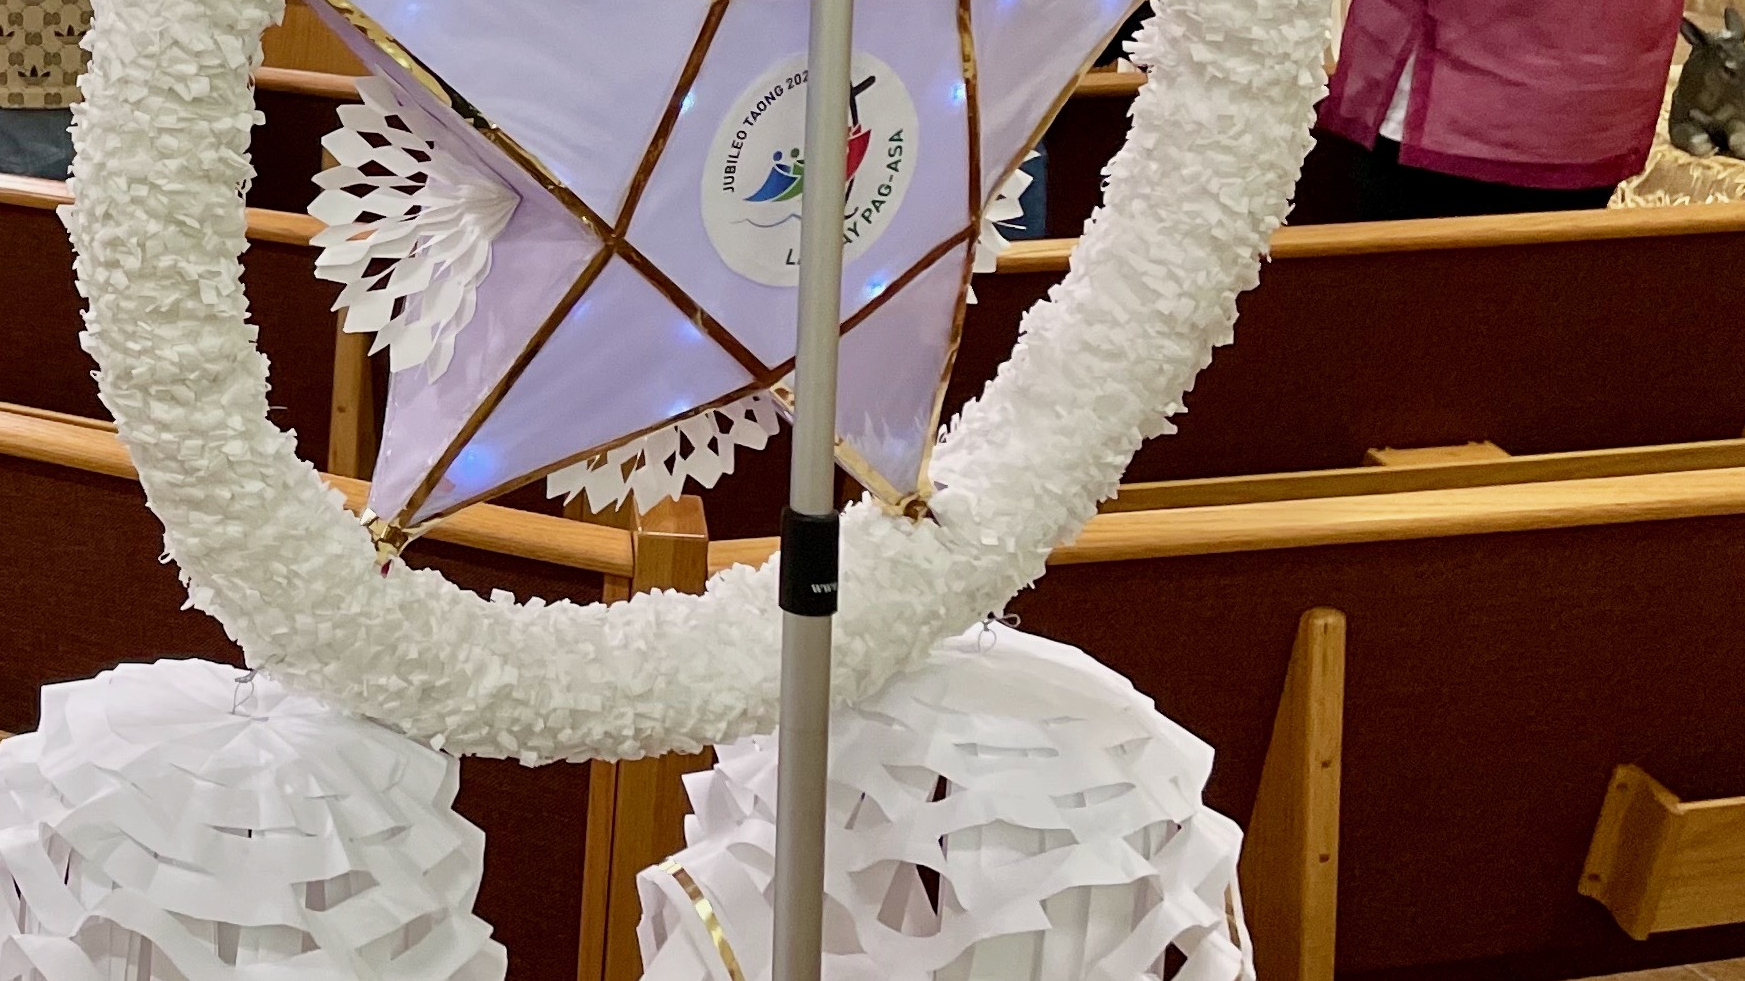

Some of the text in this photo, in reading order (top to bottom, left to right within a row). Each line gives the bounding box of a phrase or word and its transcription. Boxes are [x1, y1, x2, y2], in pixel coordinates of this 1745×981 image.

[723, 69, 809, 193] JUBILEO TAONG 202
[860, 128, 904, 224] PAG-ASA
